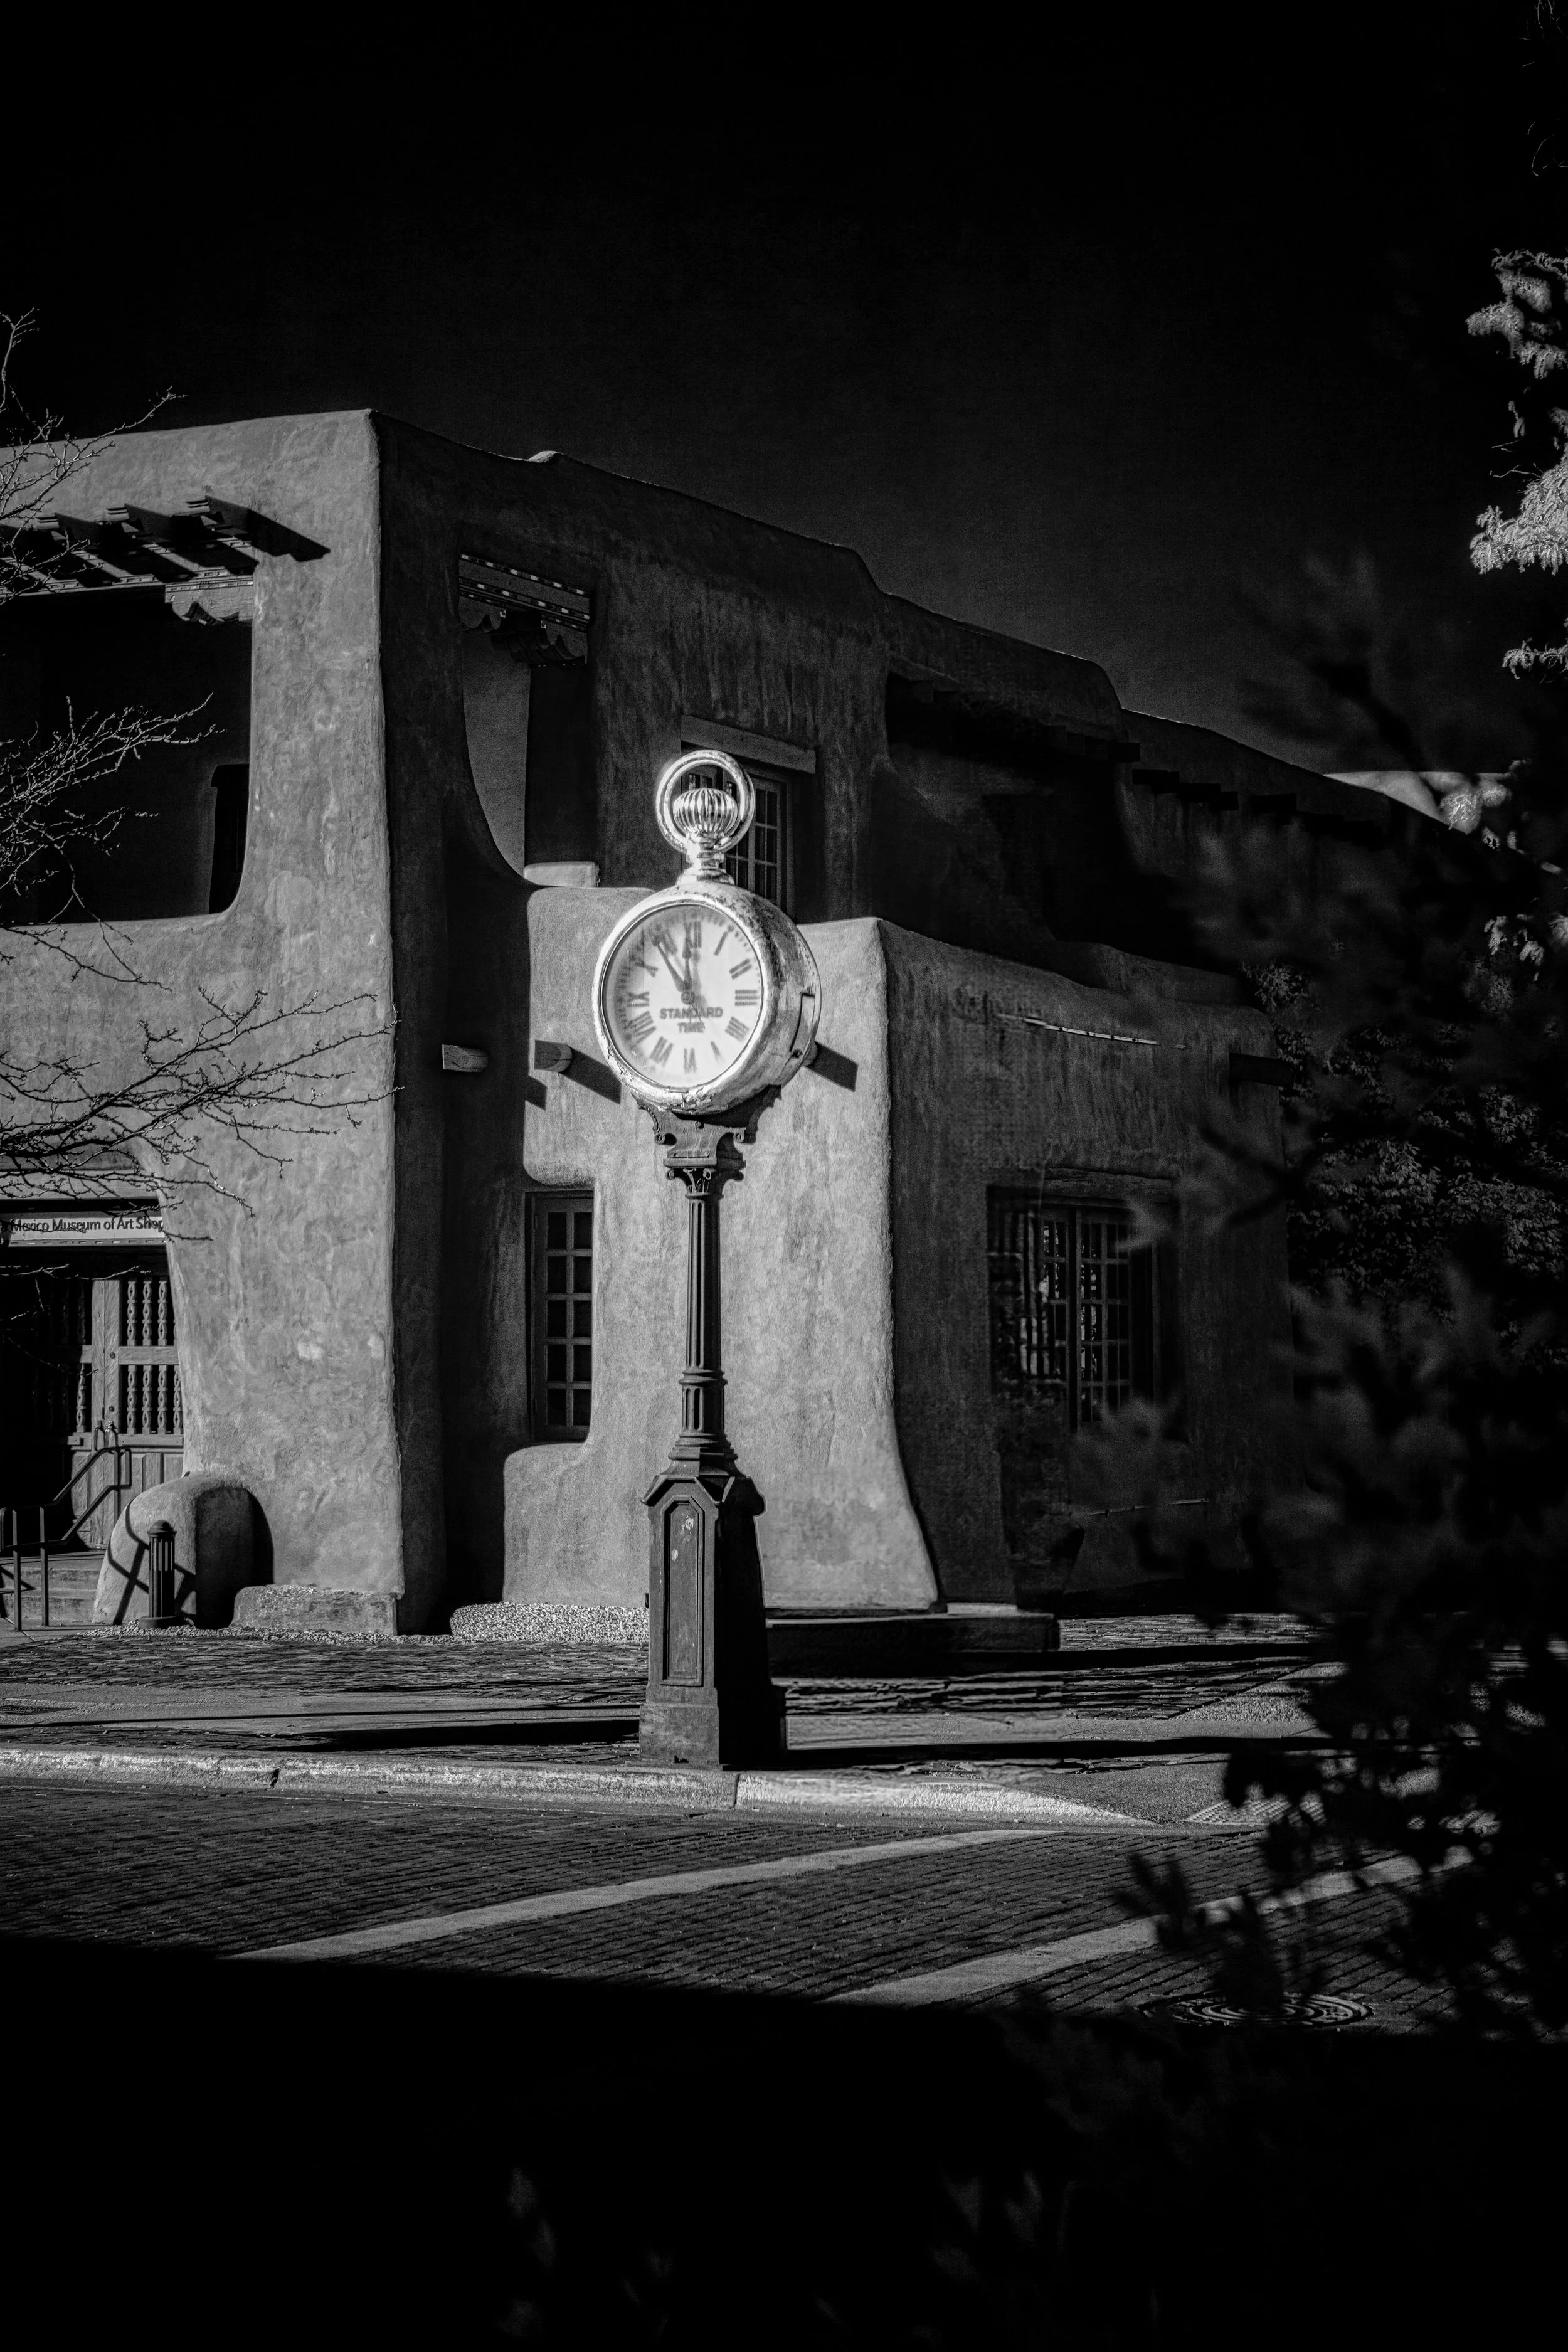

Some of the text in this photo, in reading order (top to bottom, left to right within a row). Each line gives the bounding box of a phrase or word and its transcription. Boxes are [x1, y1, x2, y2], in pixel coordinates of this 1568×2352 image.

[729, 958, 753, 980] II
[627, 991, 650, 1007] IX
[734, 989, 758, 1006] III
[660, 1007, 723, 1019] STANDARD
[677, 1022, 704, 1034] TIME
[684, 1047, 698, 1074] VI
[11, 1219, 50, 1231] Mexico
[52, 1218, 101, 1231] Museum
[103, 1216, 115, 1230] of
[117, 1216, 134, 1230] Art
